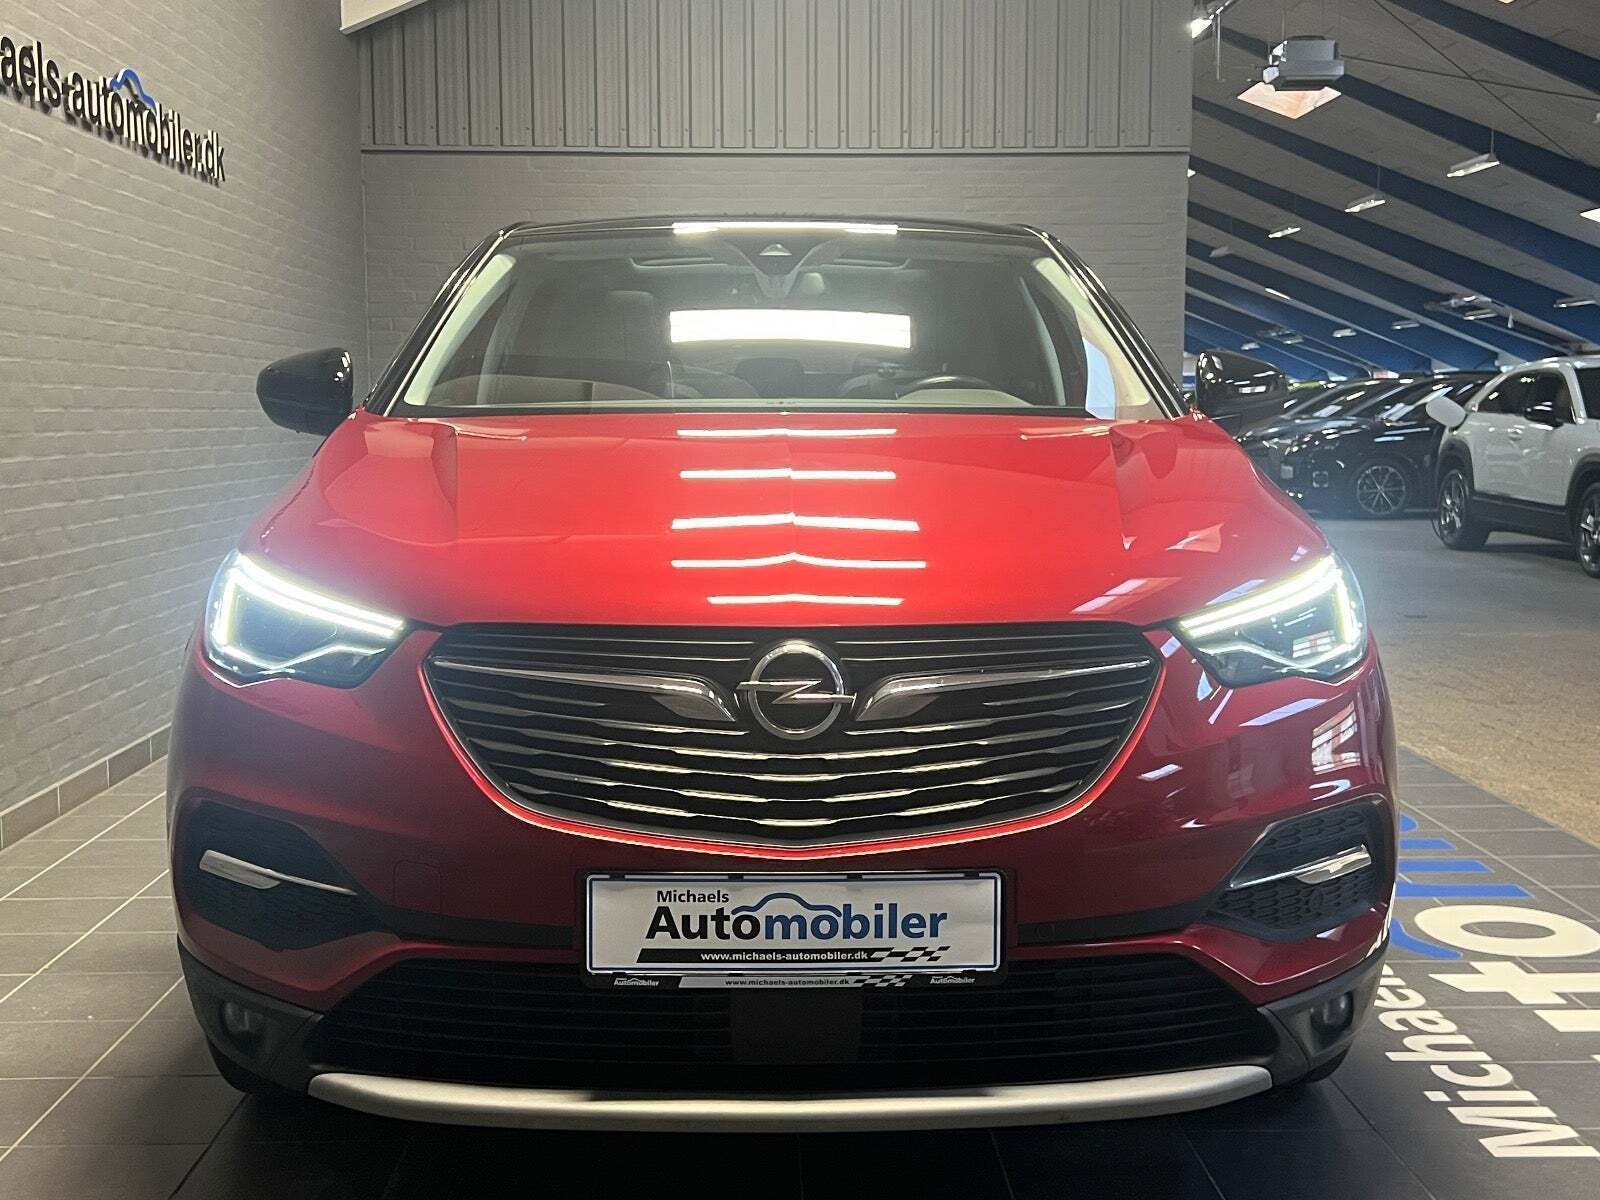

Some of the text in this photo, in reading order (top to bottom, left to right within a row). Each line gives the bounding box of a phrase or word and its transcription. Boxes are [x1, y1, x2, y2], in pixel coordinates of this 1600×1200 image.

[656, 889, 730, 903] Michaels
[645, 903, 948, 940] Automobiler
[700, 951, 868, 961] www.michaels-automobiler.dk
